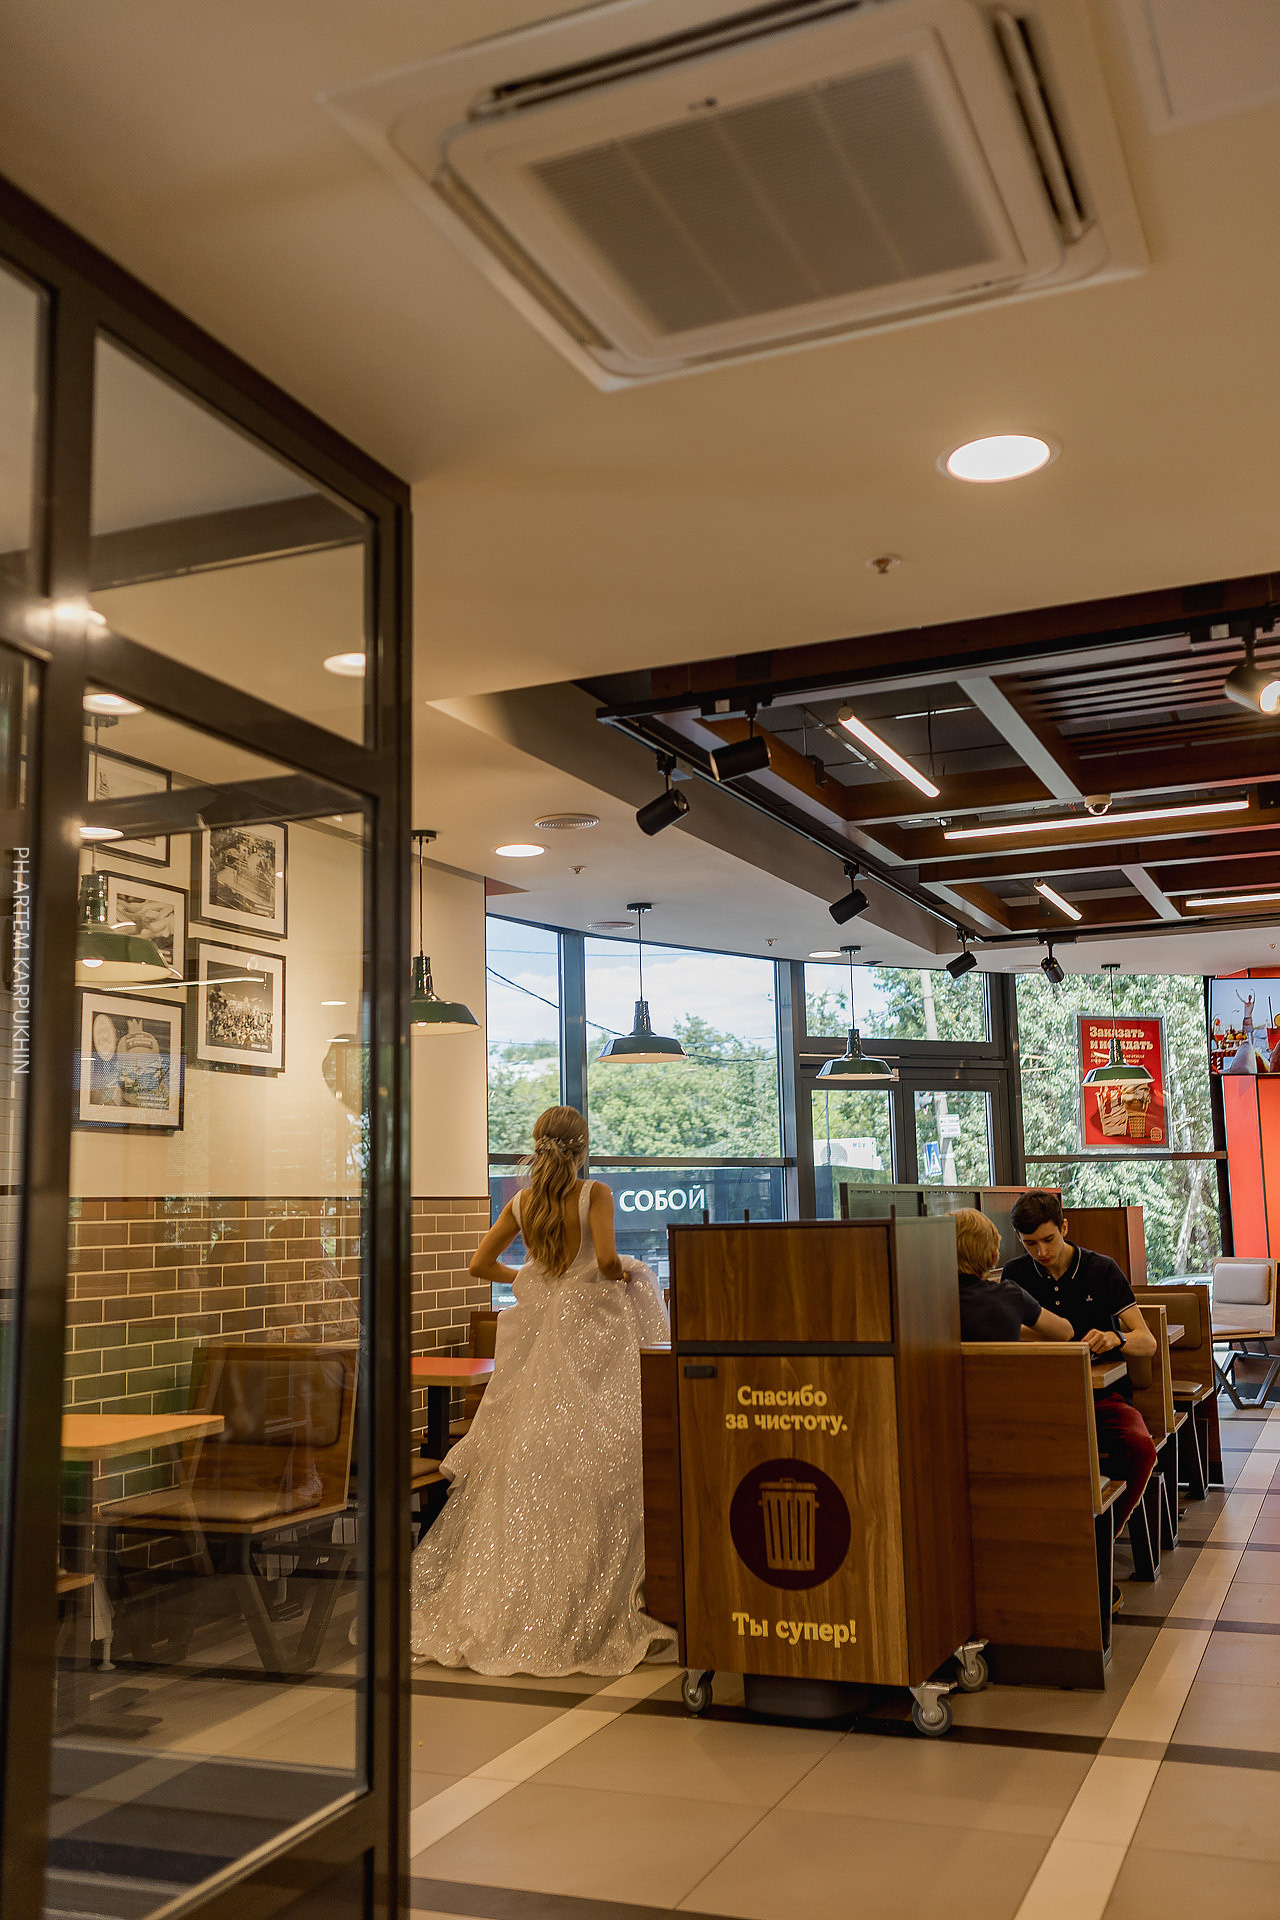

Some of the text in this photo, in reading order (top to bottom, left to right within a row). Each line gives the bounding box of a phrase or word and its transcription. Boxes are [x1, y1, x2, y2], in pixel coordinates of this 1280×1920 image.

[1089, 1025, 1145, 1038] Заказать
[1089, 1040, 1099, 1050] и
[619, 1184, 706, 1212] СОБОЙ
[737, 1384, 828, 1407] Спасибо
[725, 1413, 849, 1436] за чистоту.
[732, 1611, 857, 1648] Ты супер!
